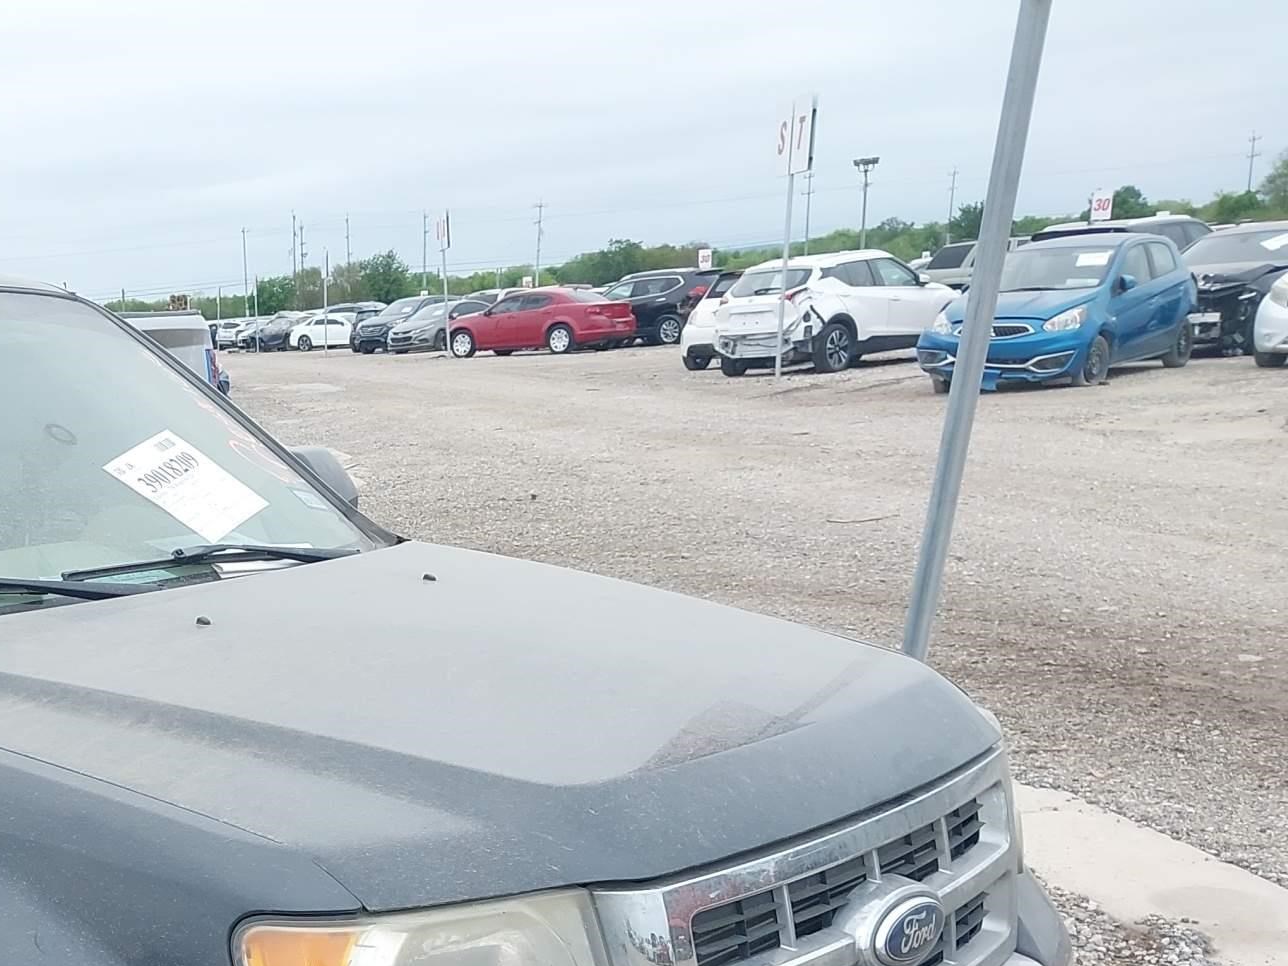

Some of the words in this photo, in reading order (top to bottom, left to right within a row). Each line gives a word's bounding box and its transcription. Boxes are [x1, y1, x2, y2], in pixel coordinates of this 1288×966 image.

[777, 120, 787, 155] S
[797, 115, 807, 150] T
[1093, 198, 1111, 211] 30
[137, 451, 199, 493] 39018209
[900, 910, 937, 954] Ford
